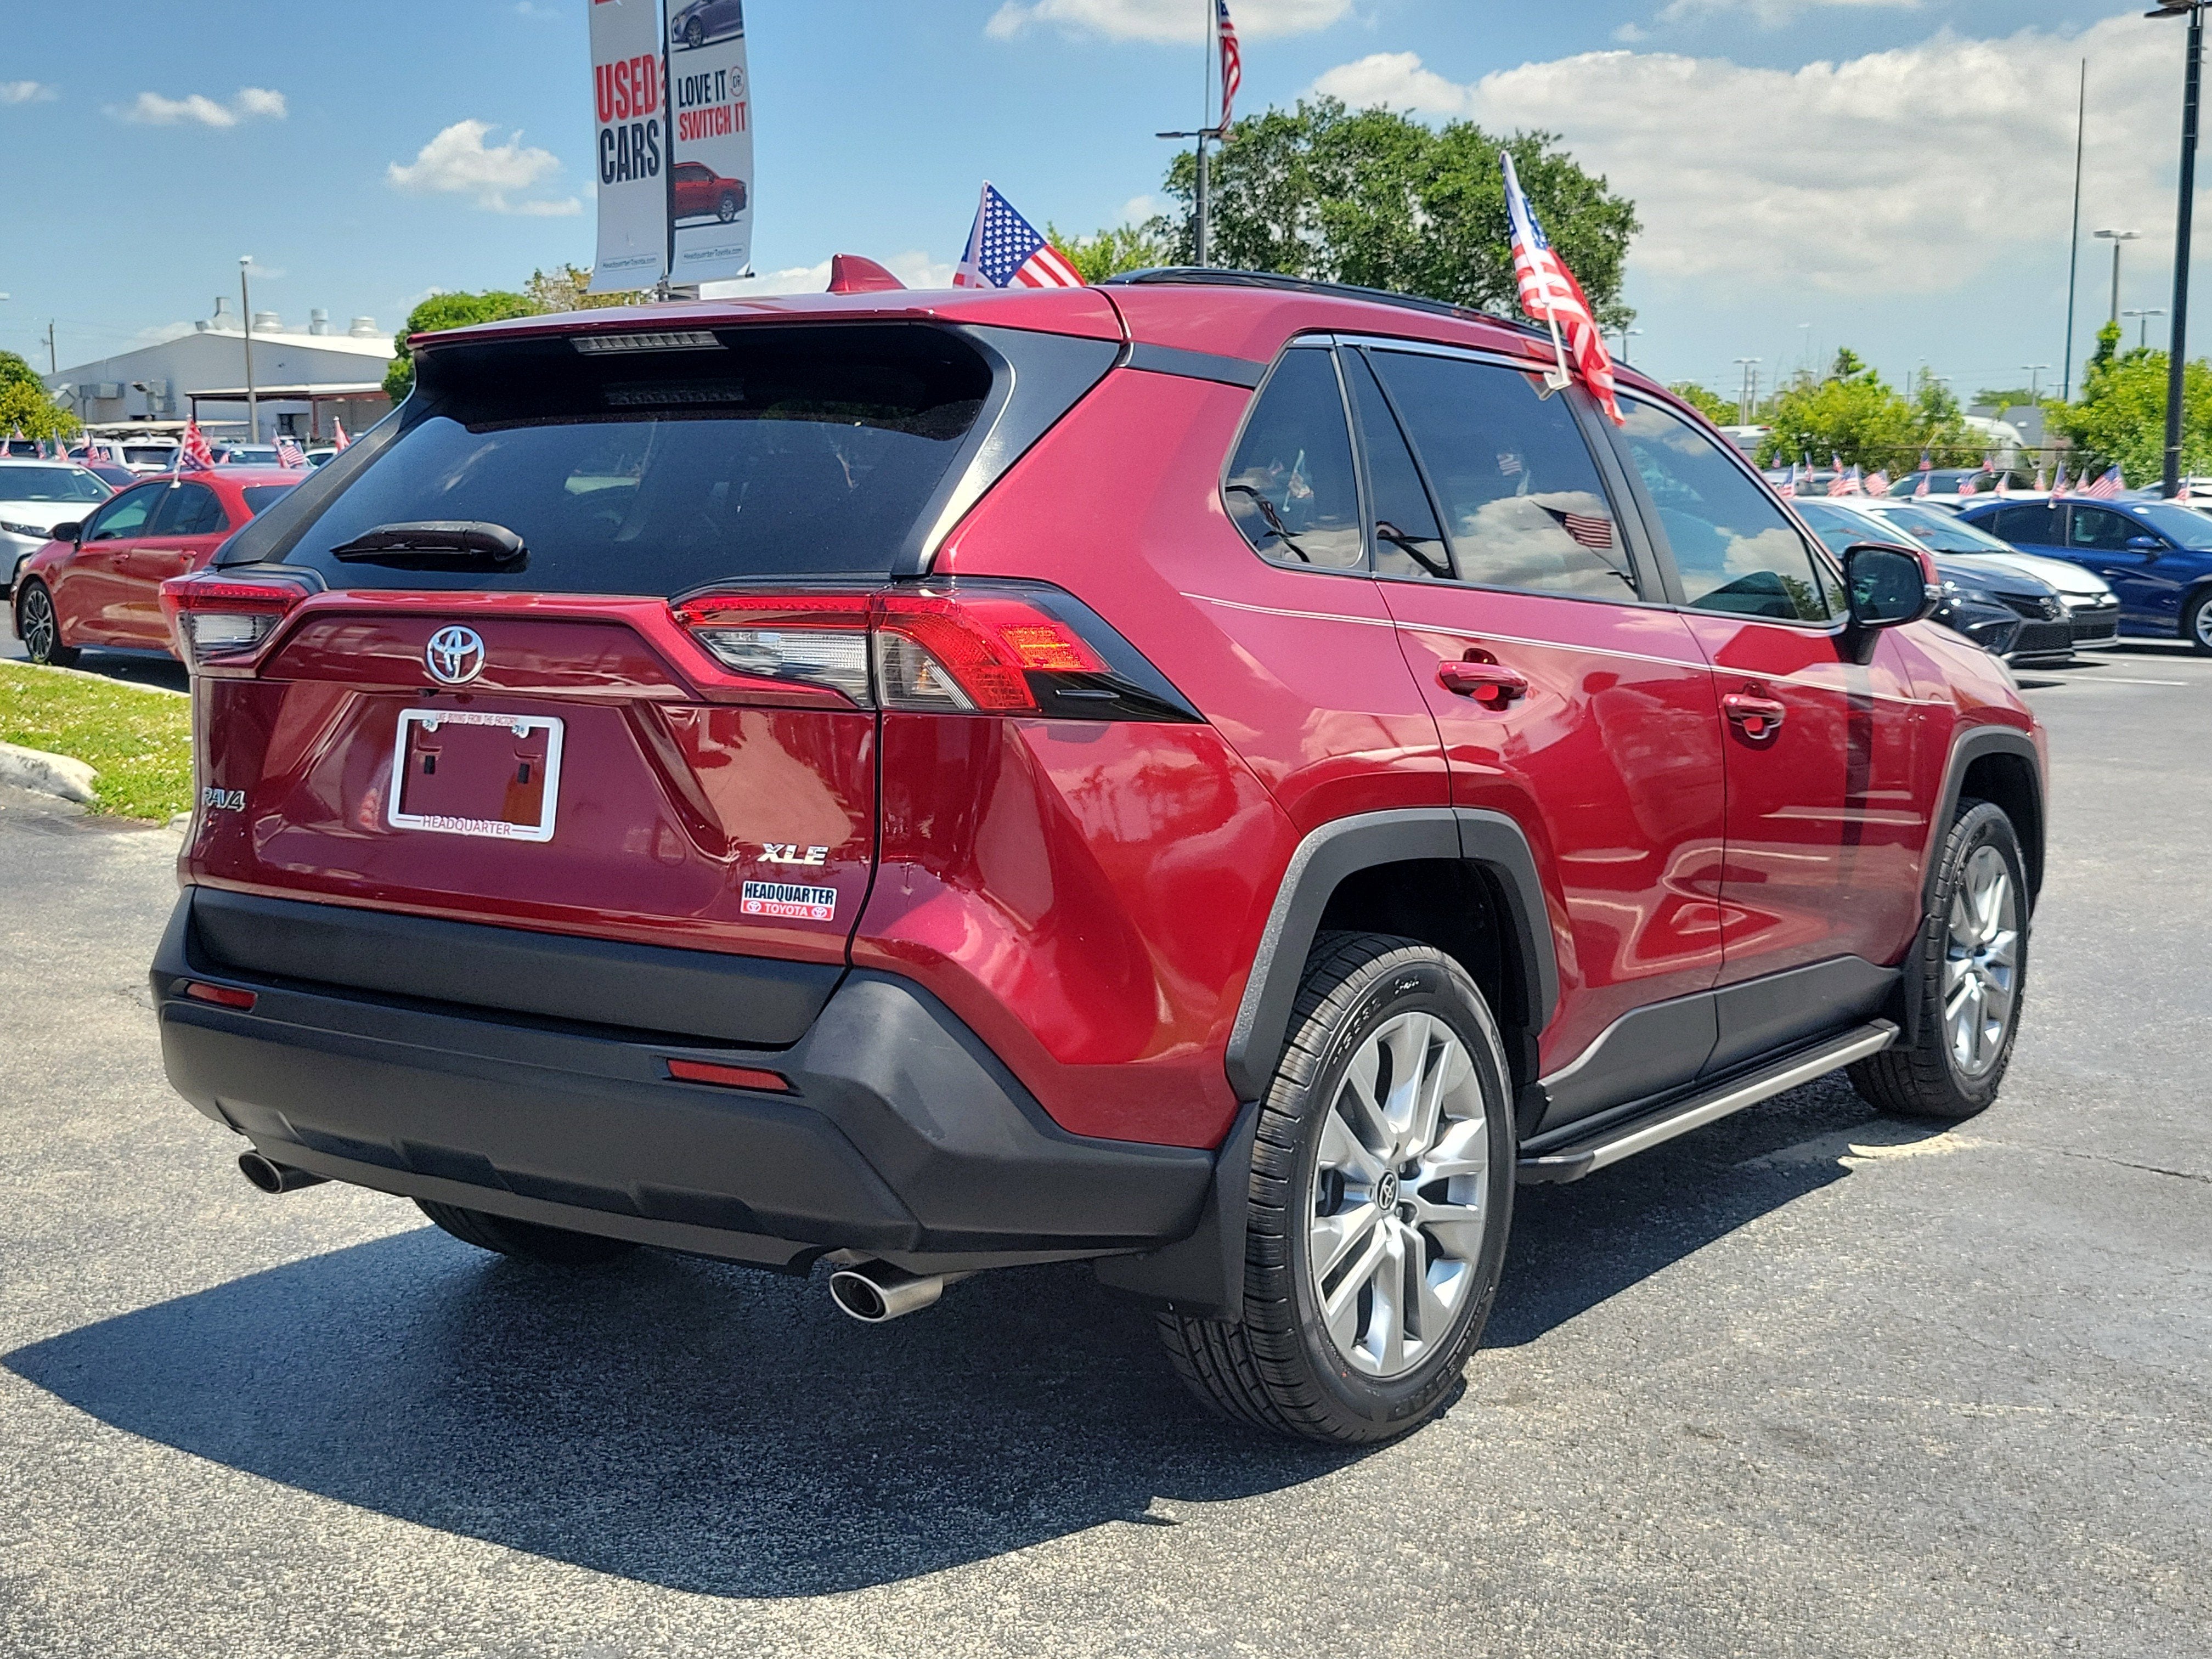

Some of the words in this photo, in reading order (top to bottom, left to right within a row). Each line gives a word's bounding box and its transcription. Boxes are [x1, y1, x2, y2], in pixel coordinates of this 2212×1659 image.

[596, 54, 658, 124] USED
[678, 73, 712, 108] LOVE
[715, 69, 726, 102] IT
[679, 105, 732, 142] SWITCH
[735, 101, 747, 133] IT
[600, 119, 661, 185] CARS
[201, 787, 246, 812] RAV4
[422, 816, 511, 835] HEADQUARTER
[757, 843, 829, 866] XLE
[744, 882, 834, 905] HEADQUARTER
[765, 903, 808, 916] TOYOTA
